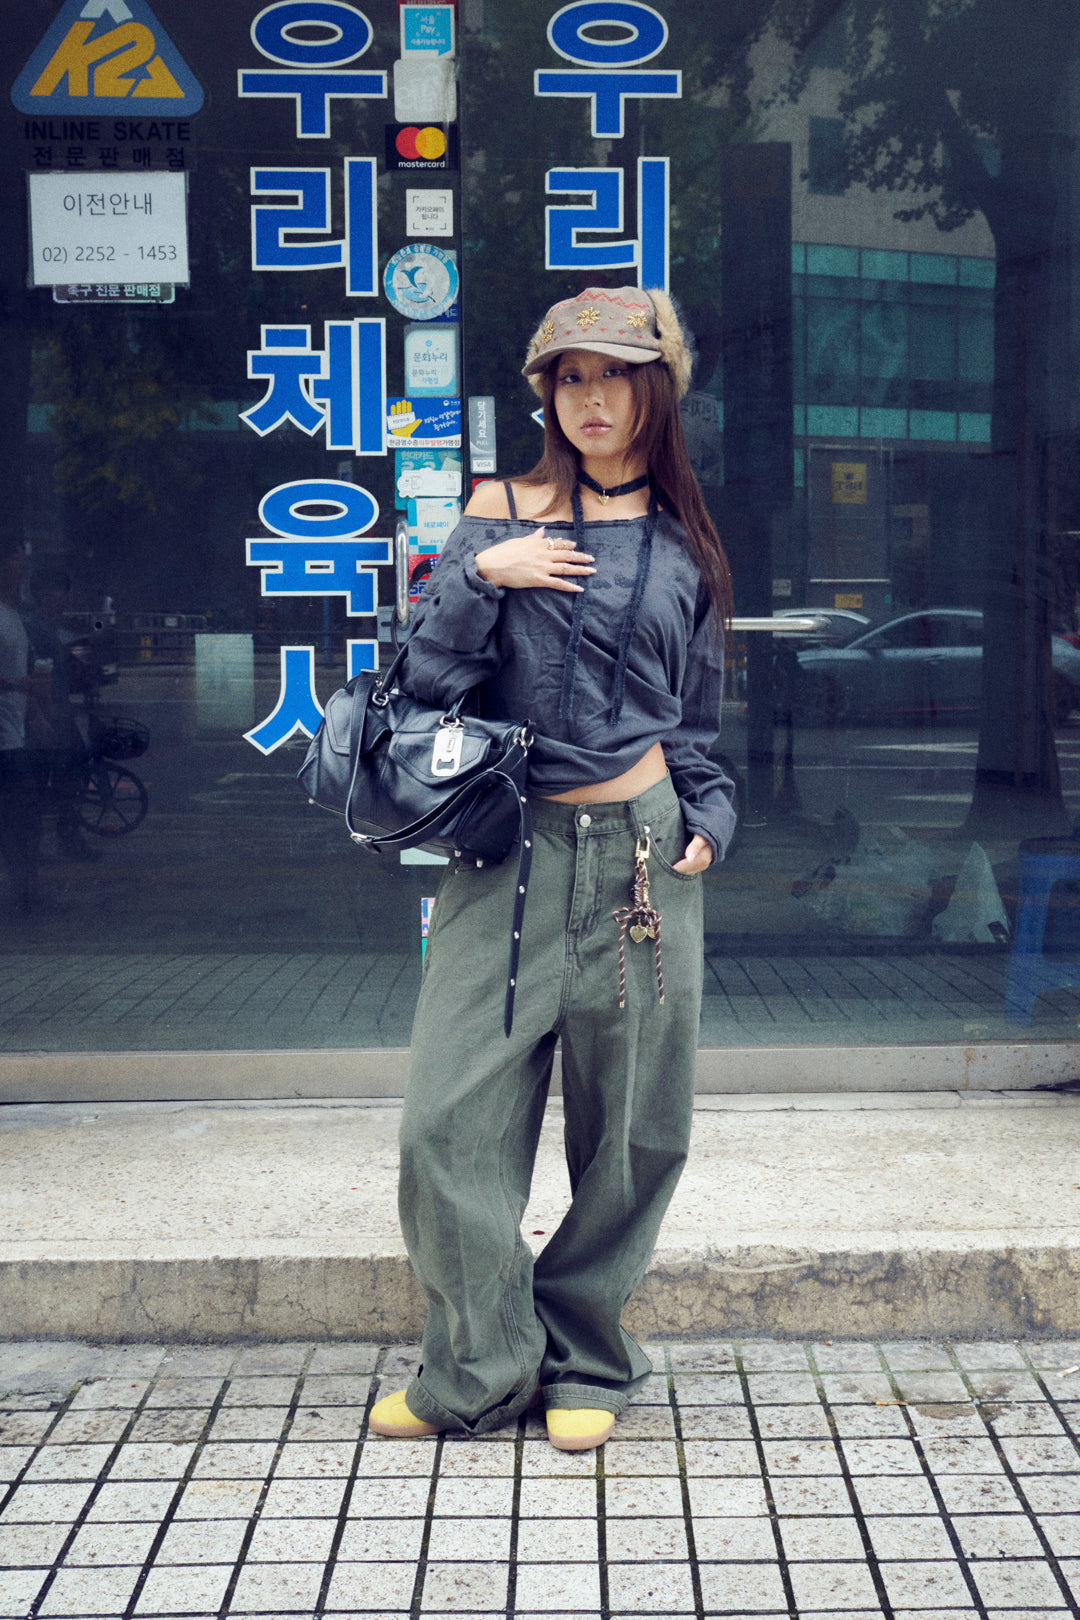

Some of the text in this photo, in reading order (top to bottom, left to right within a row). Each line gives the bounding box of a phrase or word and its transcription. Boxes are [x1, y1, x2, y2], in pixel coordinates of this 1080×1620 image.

[420, 24, 436, 35] Pay
[30, 21, 185, 97] K2
[24, 122, 191, 141] INLINE SKATE
[398, 160, 446, 168] mastercard
[63, 192, 153, 216] 이전안내
[42, 246, 69, 264] 02)
[75, 246, 116, 262] 2252
[137, 245, 178, 261] 1453
[96, 284, 121, 297] 전문
[123, 284, 161, 297] 판매점
[413, 350, 449, 363] 문화누리
[477, 400, 488, 438] 당기세요
[400, 450, 435, 461] 현대카드
